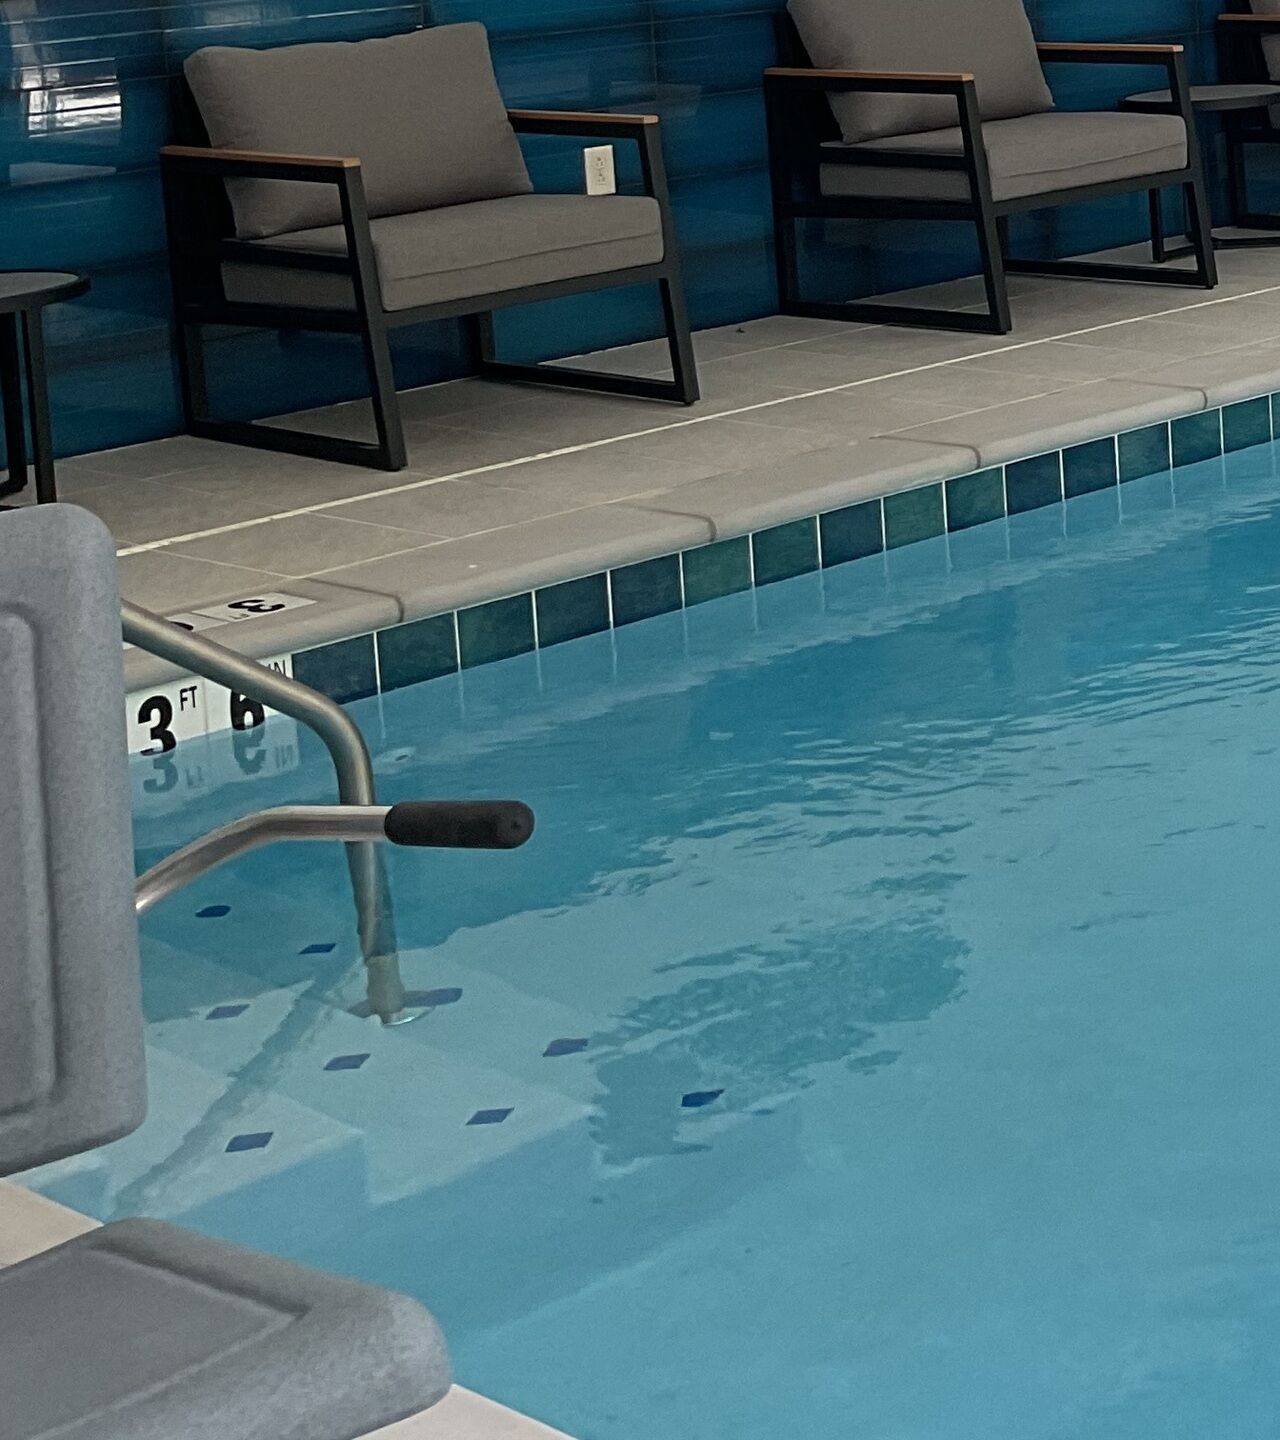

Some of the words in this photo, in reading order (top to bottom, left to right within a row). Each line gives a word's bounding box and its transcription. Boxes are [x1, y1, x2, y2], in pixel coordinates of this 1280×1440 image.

[137, 695, 177, 757] 3
[179, 686, 198, 711] FT
[230, 689, 265, 731] 6
